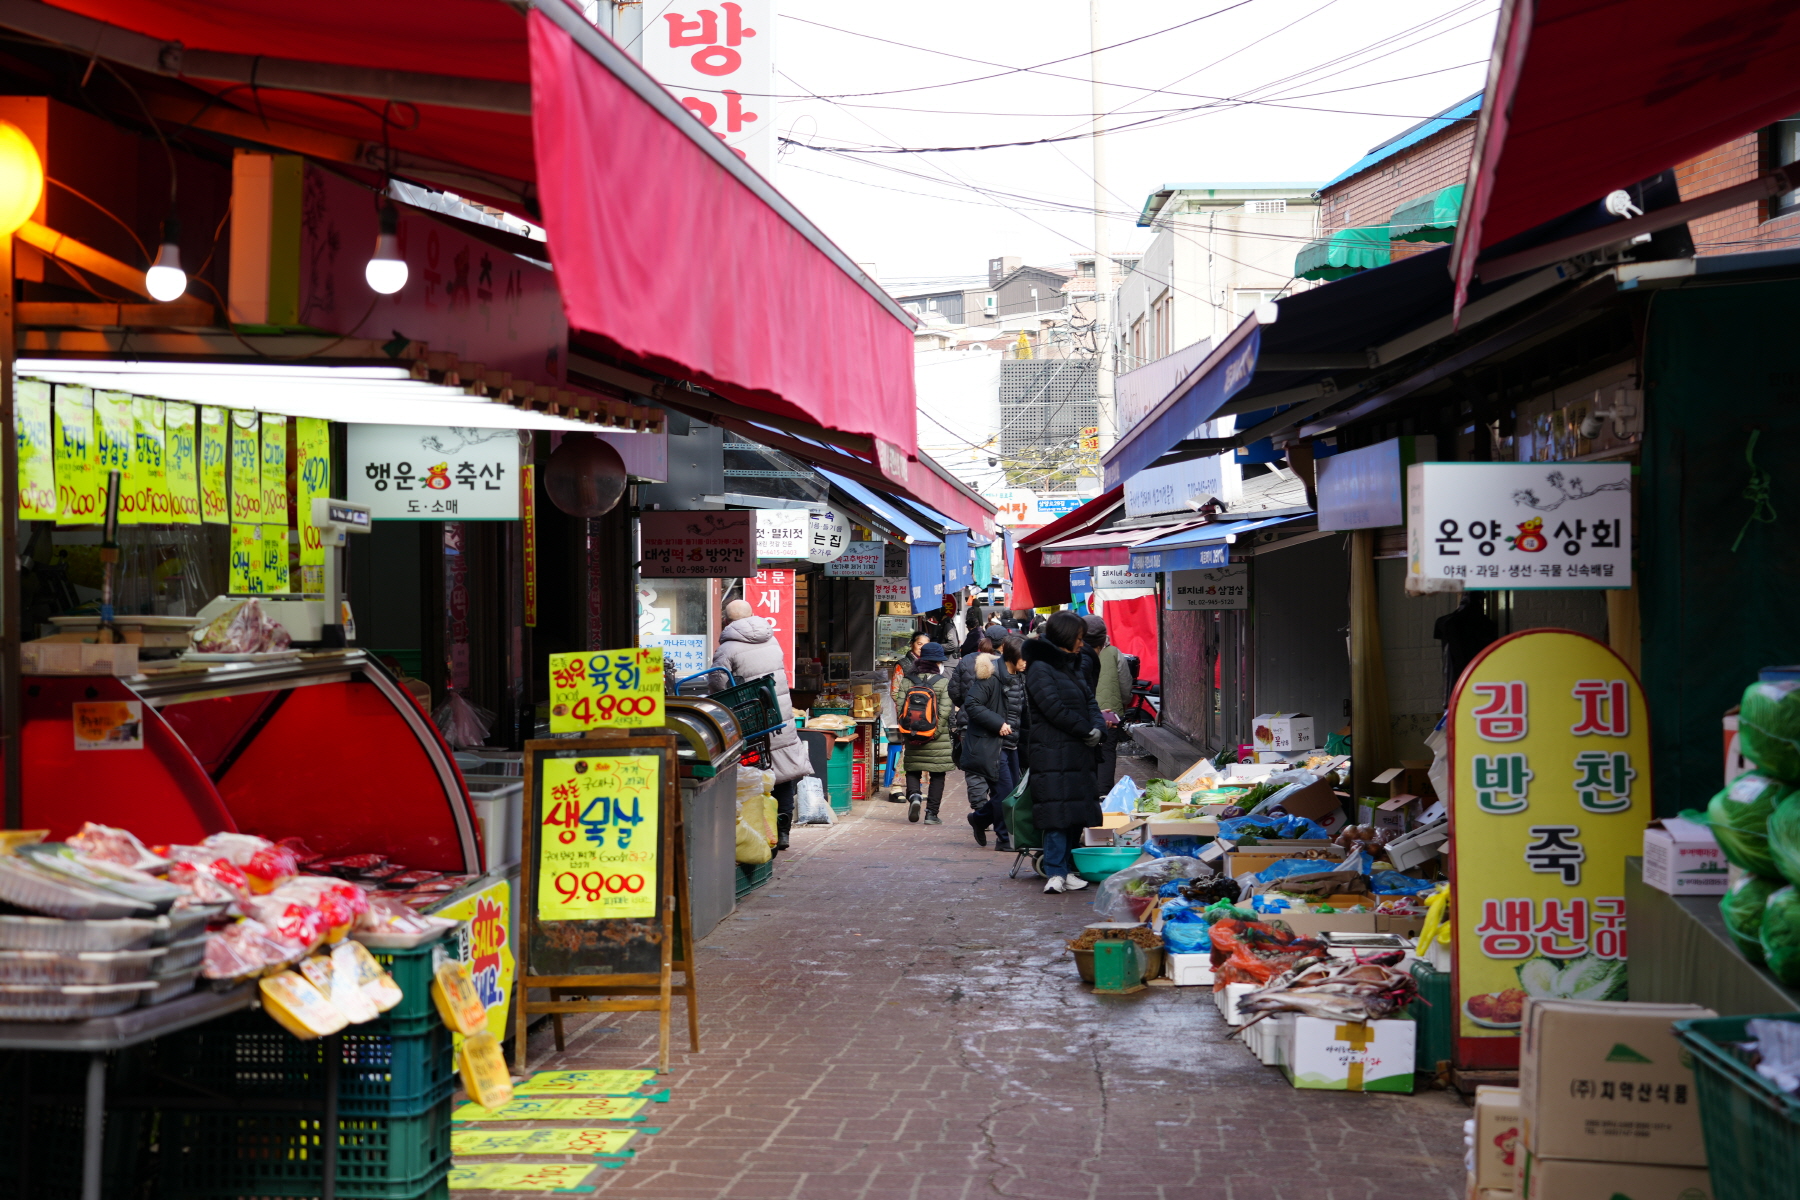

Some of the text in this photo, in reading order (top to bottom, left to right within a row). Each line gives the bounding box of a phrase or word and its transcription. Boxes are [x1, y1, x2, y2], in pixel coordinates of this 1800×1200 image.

[365, 461, 505, 491] 행운 축산
[993, 503, 1028, 522] 시장
[1435, 518, 1621, 556] 온양 상회
[644, 548, 745, 562] 대성떡 방앗간
[676, 566, 727, 574] 02-988-7691
[1566, 564, 1615, 578] 신속배달
[1177, 585, 1244, 596] 돼지네 삼겹살
[663, 639, 703, 648] 까나리액젓
[588, 654, 641, 694] 육회
[1472, 680, 1629, 742] 김치
[1473, 751, 1636, 814] 반찬
[542, 796, 645, 849] 생목살
[1524, 825, 1584, 886] 죽
[472, 917, 500, 959] SALE
[1570, 1078, 1688, 1104] (주) 치악산식품
